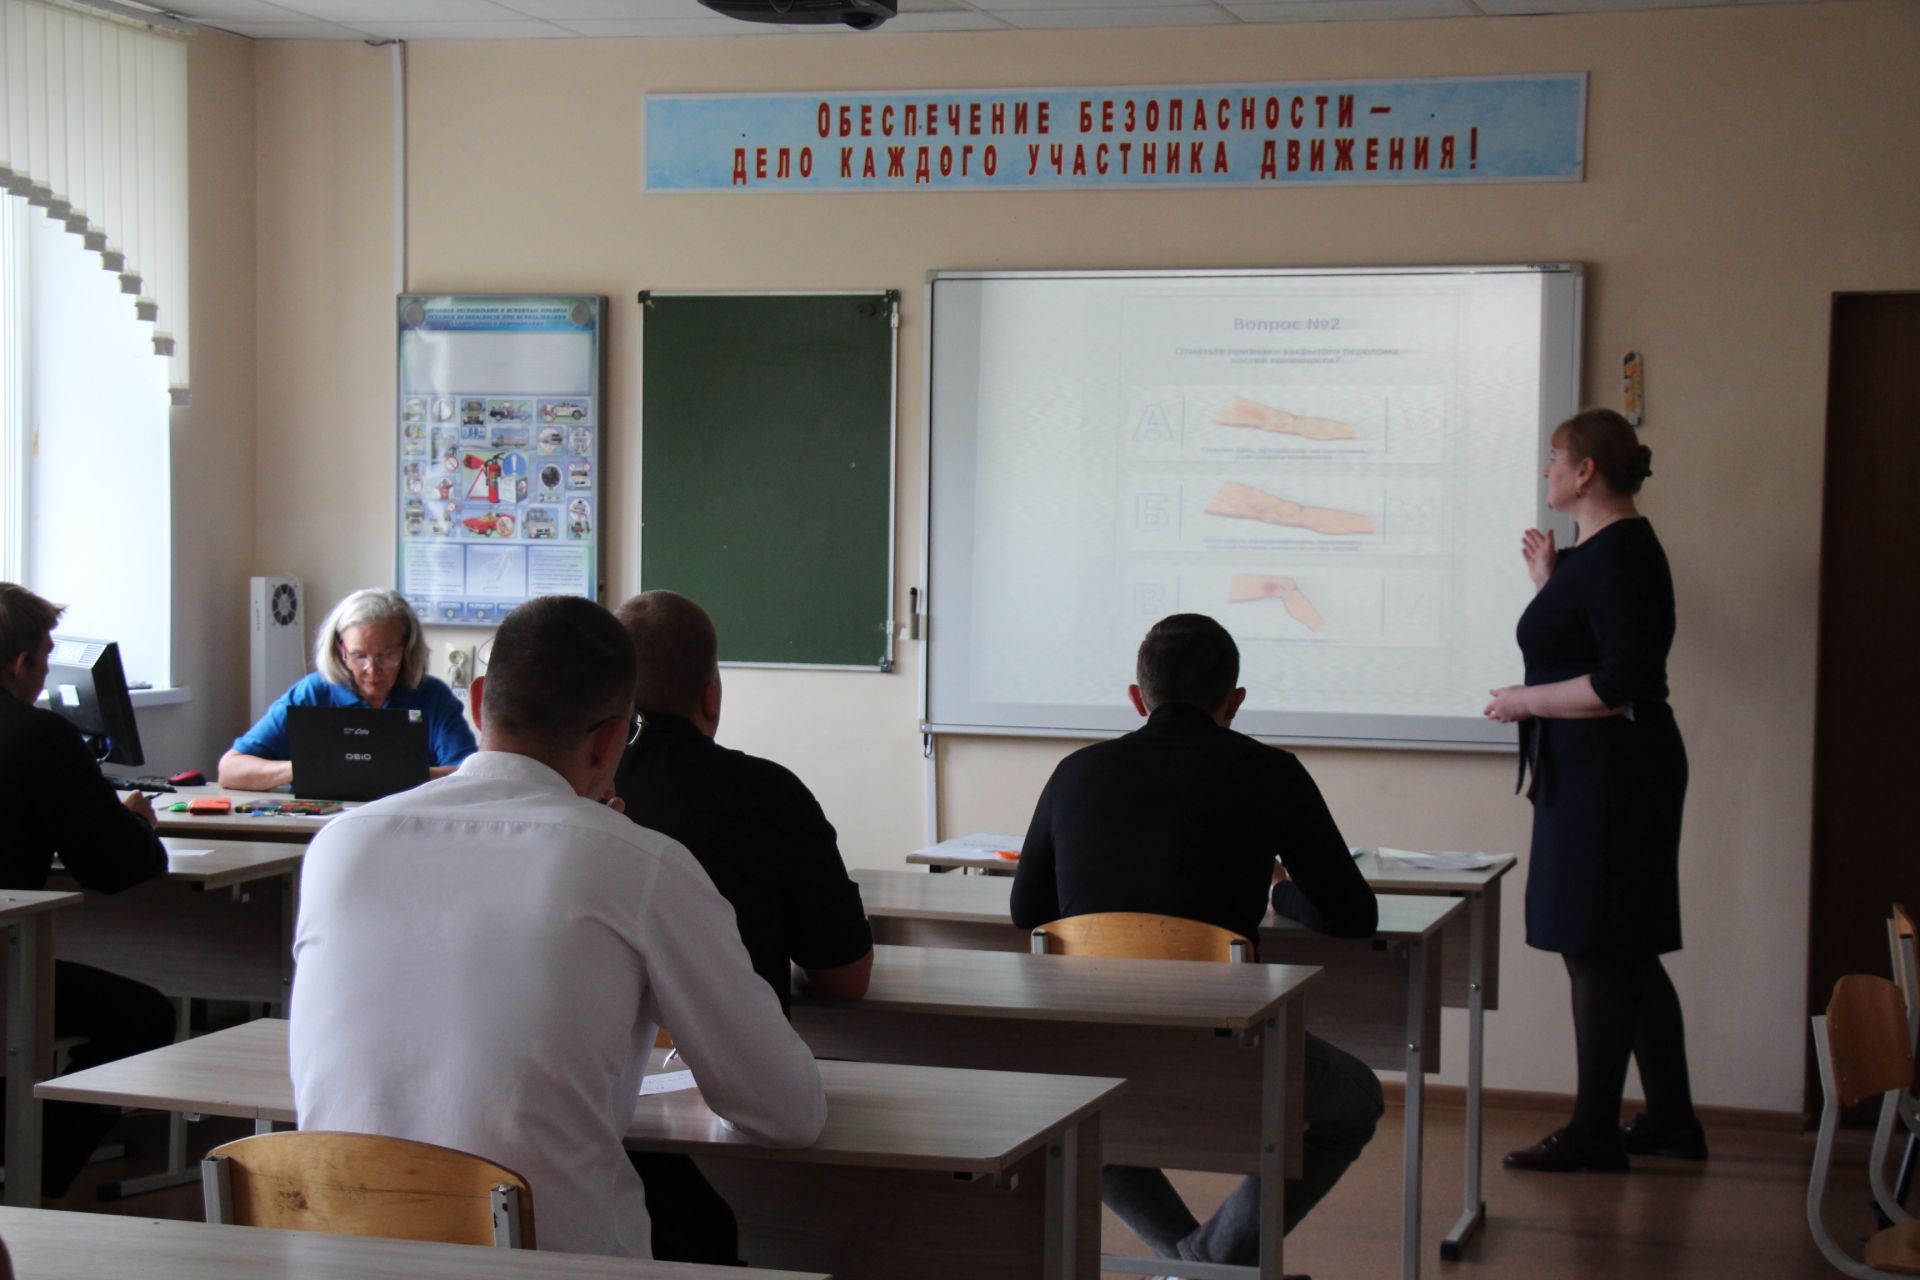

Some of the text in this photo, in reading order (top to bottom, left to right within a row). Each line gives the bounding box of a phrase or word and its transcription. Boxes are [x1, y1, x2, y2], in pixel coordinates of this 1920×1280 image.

[817, 101, 1050, 138] ОБЕСПЕЧЕНИЕ
[1079, 94, 1354, 134] БЕЗОПАСНОСТИ
[732, 126, 1478, 184] ДЕЛО КАЖДОГО УЧАСТНИКА ДВИЖЕНИЯ!
[1233, 318, 1341, 332] Вопрос №2
[1133, 403, 1173, 441] А
[1136, 493, 1169, 532] Б
